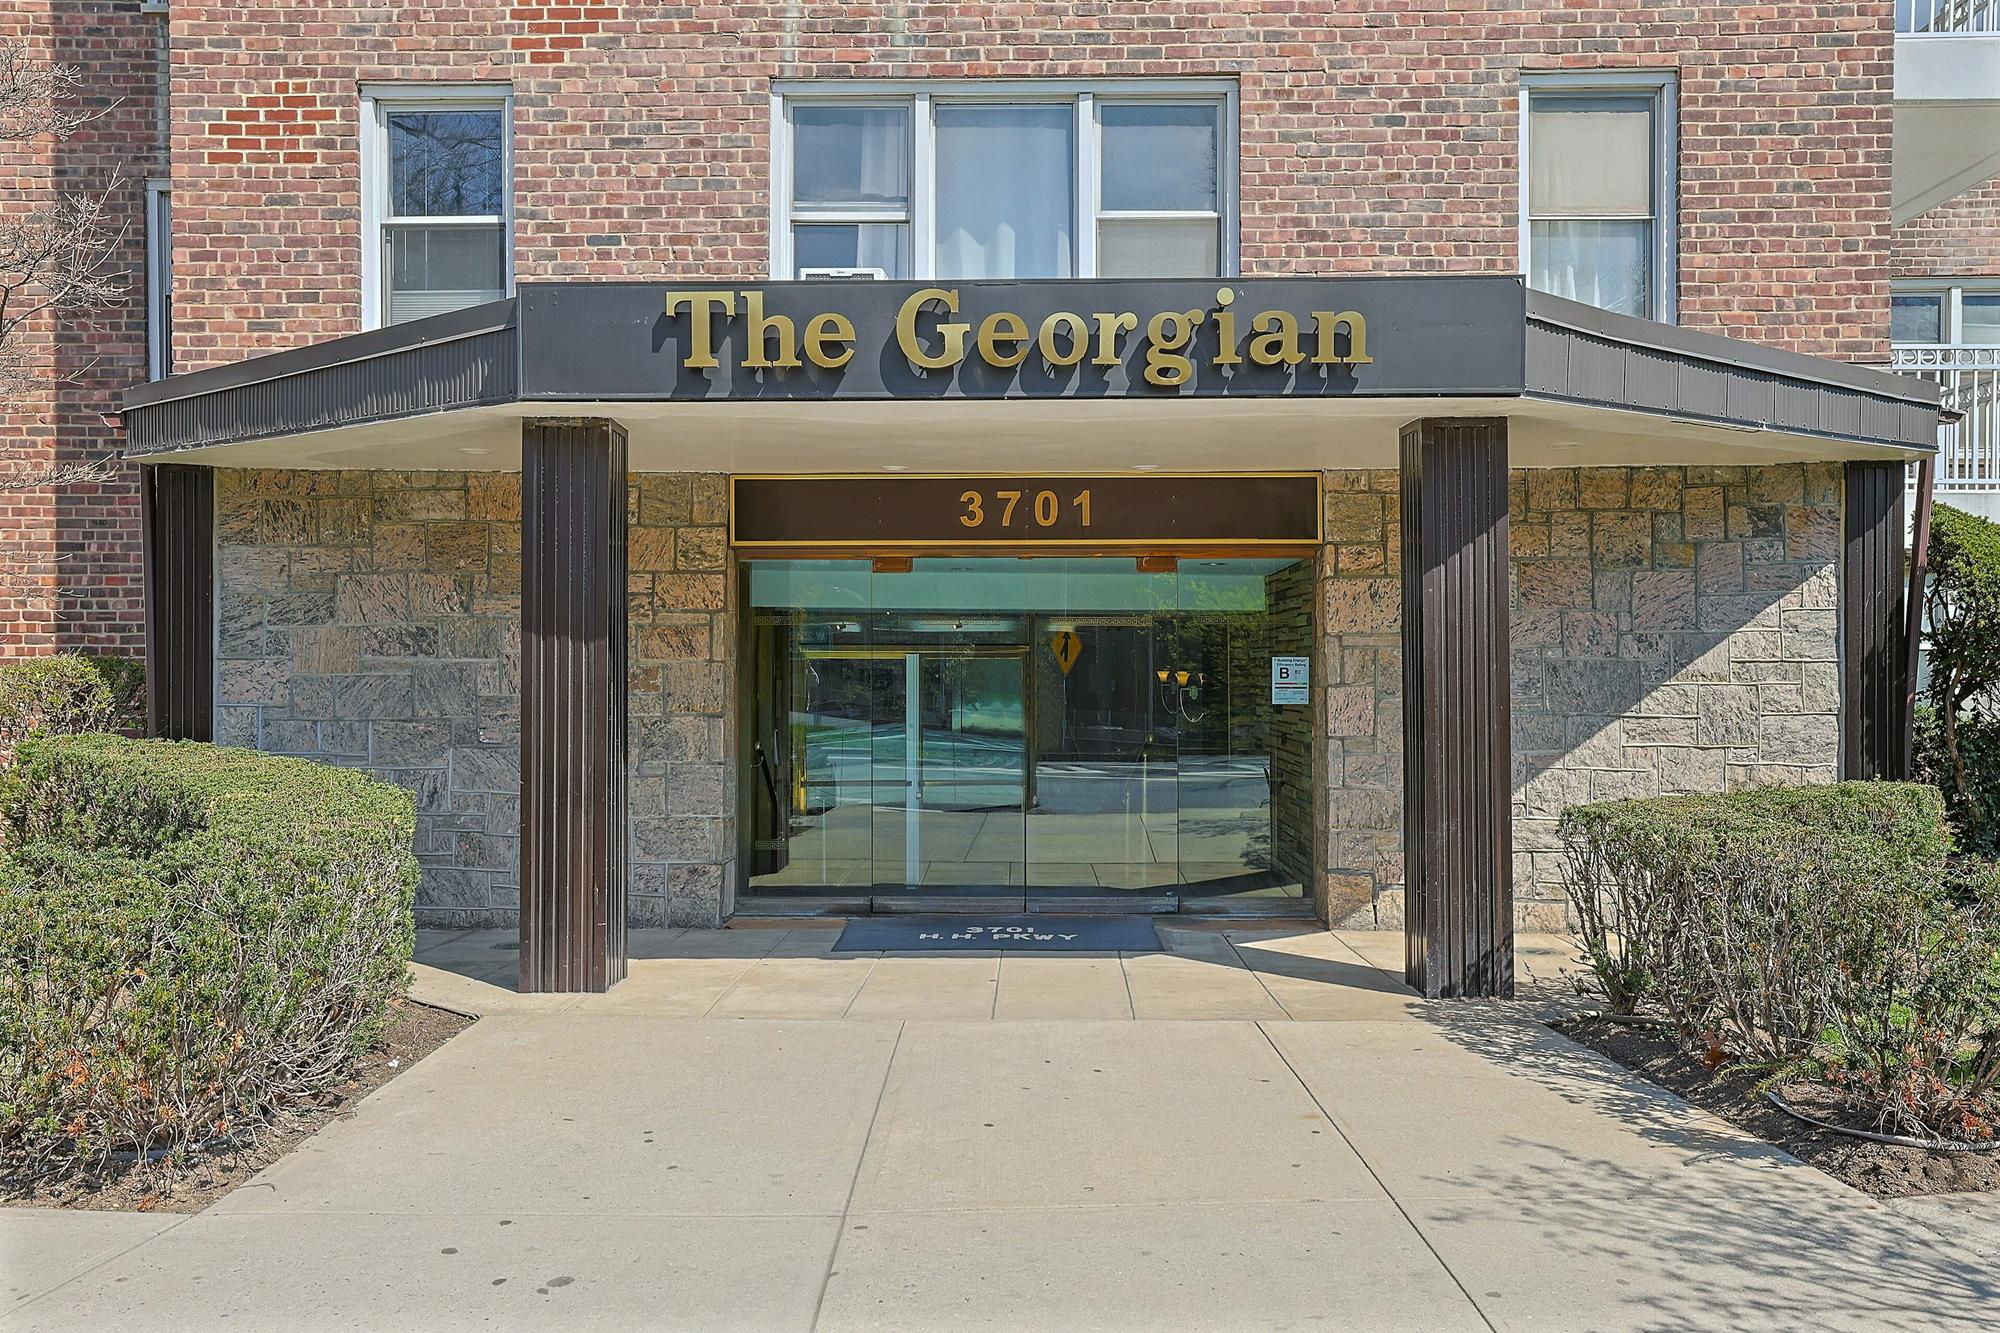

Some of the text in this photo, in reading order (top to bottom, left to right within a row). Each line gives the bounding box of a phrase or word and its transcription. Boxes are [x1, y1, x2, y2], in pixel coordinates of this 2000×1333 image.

[666, 286, 1374, 387] The Georgian
[959, 489, 1091, 527] 3701
[1279, 667, 1290, 679] B
[966, 926, 1035, 934] 3701
[993, 933, 1079, 941] PKWY
